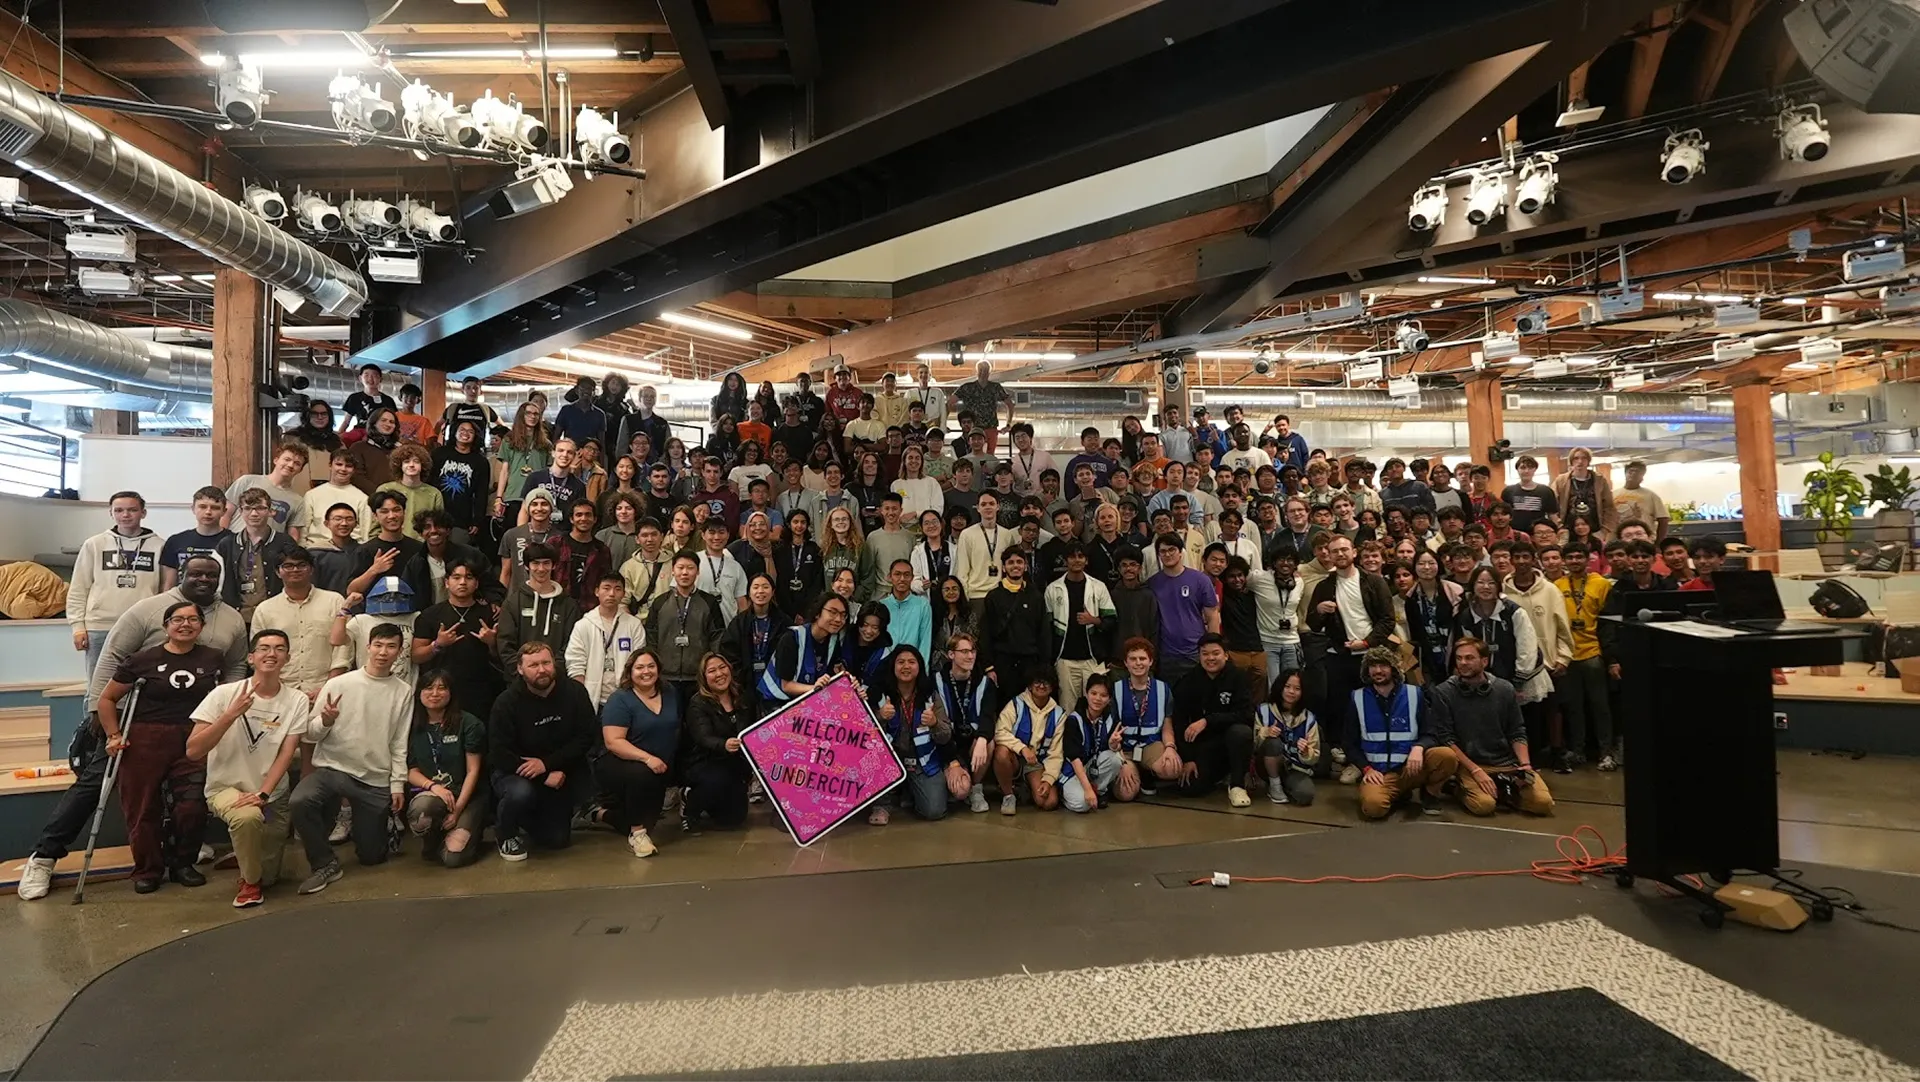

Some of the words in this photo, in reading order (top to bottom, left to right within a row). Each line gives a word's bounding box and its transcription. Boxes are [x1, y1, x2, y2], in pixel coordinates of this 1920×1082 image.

[516, 537, 526, 566] NASA
[791, 716, 871, 750] WELCOME
[815, 747, 835, 767] TO
[771, 763, 866, 799] UNDERCITY
